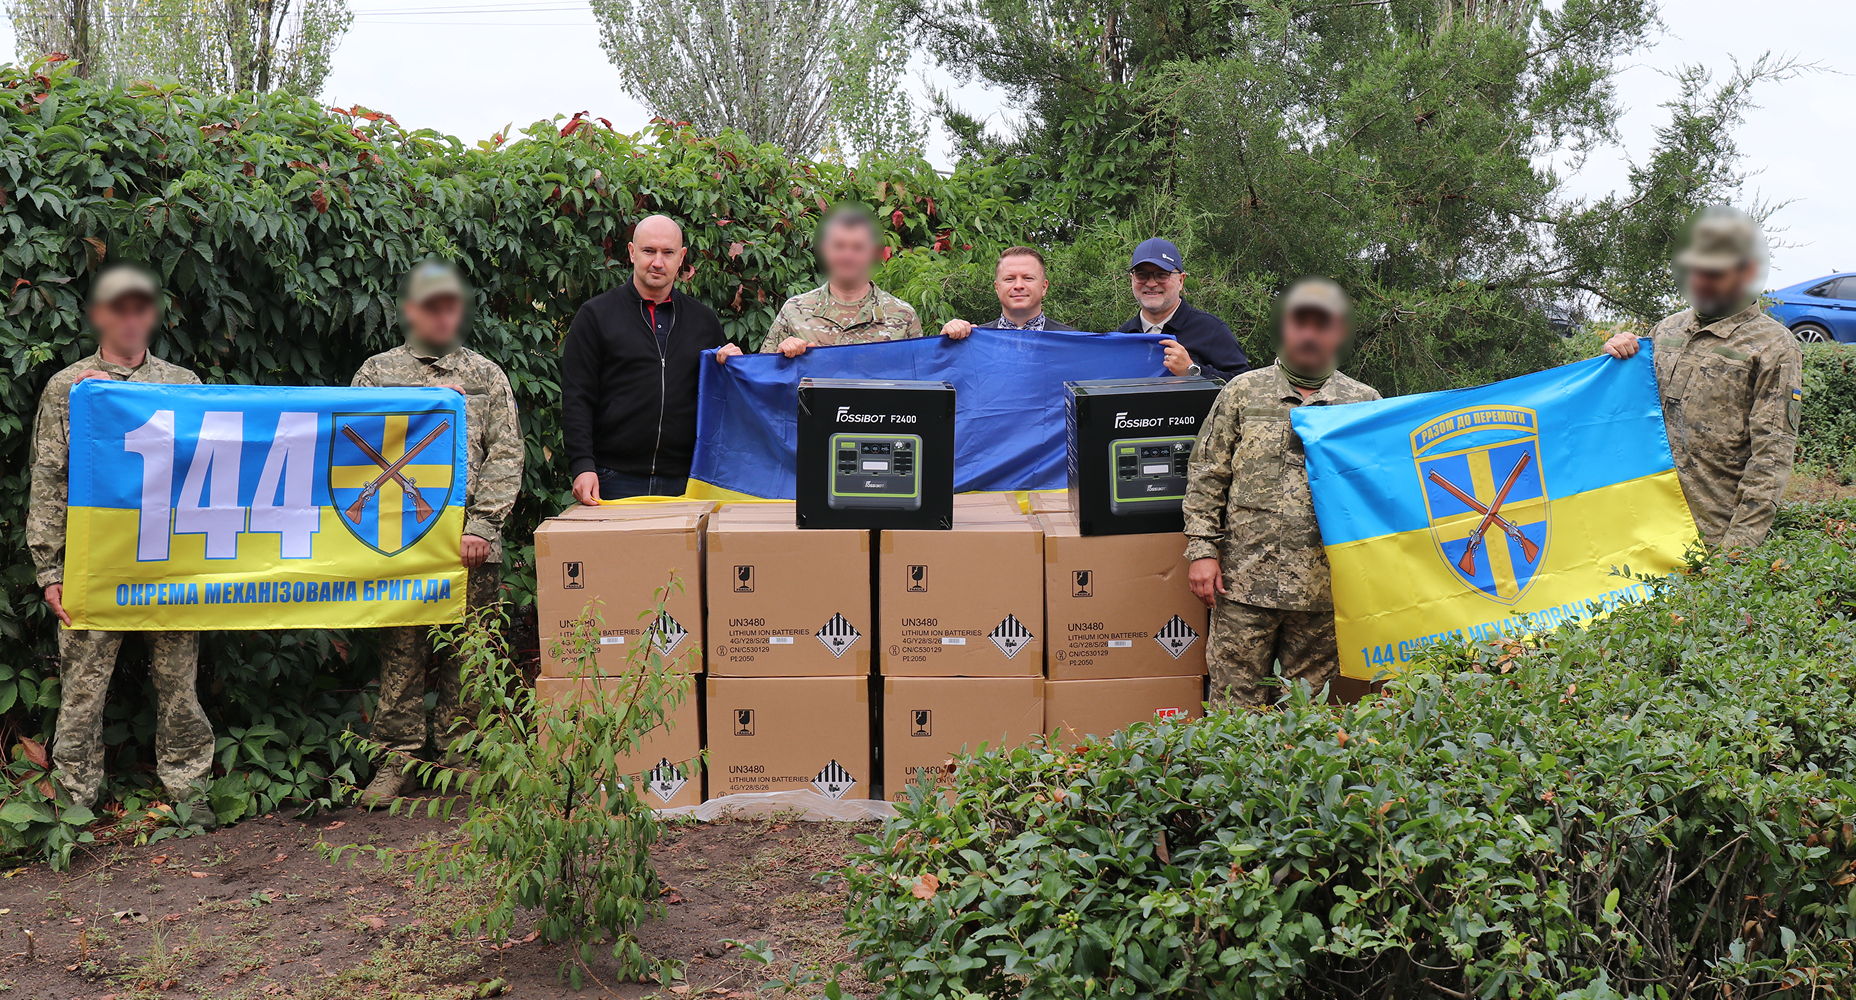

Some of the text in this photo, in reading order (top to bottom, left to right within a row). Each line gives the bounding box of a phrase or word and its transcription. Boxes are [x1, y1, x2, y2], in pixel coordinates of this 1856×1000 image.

[890, 414, 917, 424] F2400
[1168, 416, 1195, 426] F2400
[1421, 411, 1526, 443] РАЗОМ ДО ПЕРЕМОГИ
[123, 409, 321, 562] 144
[116, 579, 451, 606] ОКРЕМА МЕХАНІЗОВАНА БРИГАДА
[728, 618, 766, 627] UN3480
[901, 618, 938, 627] UN3480
[1067, 622, 1104, 631] UN3480
[602, 628, 641, 637] BATTERIES
[772, 628, 810, 636] BATTERIES
[1110, 631, 1149, 639] BATTERIES
[1361, 643, 1395, 668] 144
[728, 765, 765, 774] UN3480
